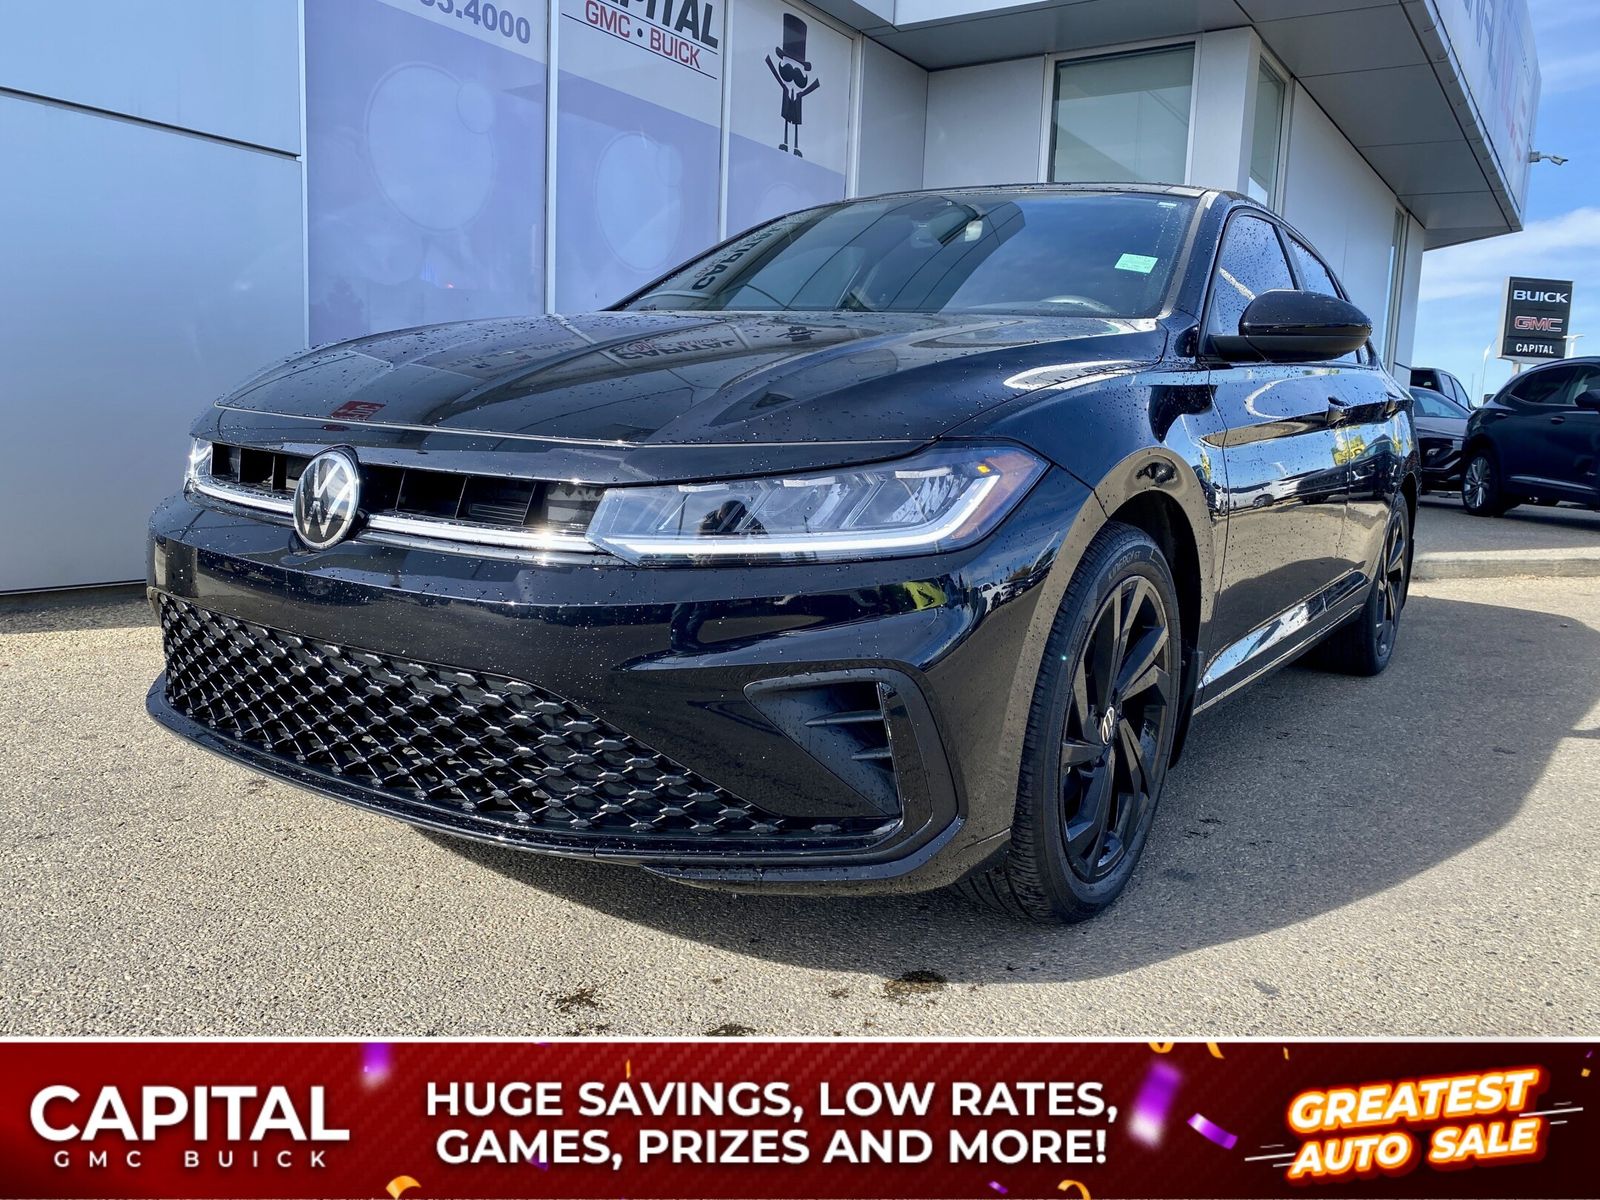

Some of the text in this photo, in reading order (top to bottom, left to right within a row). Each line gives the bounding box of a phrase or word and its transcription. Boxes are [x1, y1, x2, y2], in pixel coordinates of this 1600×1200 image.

[420, 0, 530, 44] .4000
[585, 0, 701, 69] GMC BUICK
[1513, 289, 1568, 303] BUICK
[1514, 315, 1563, 332] GMC
[1515, 343, 1554, 354] CAPITAL
